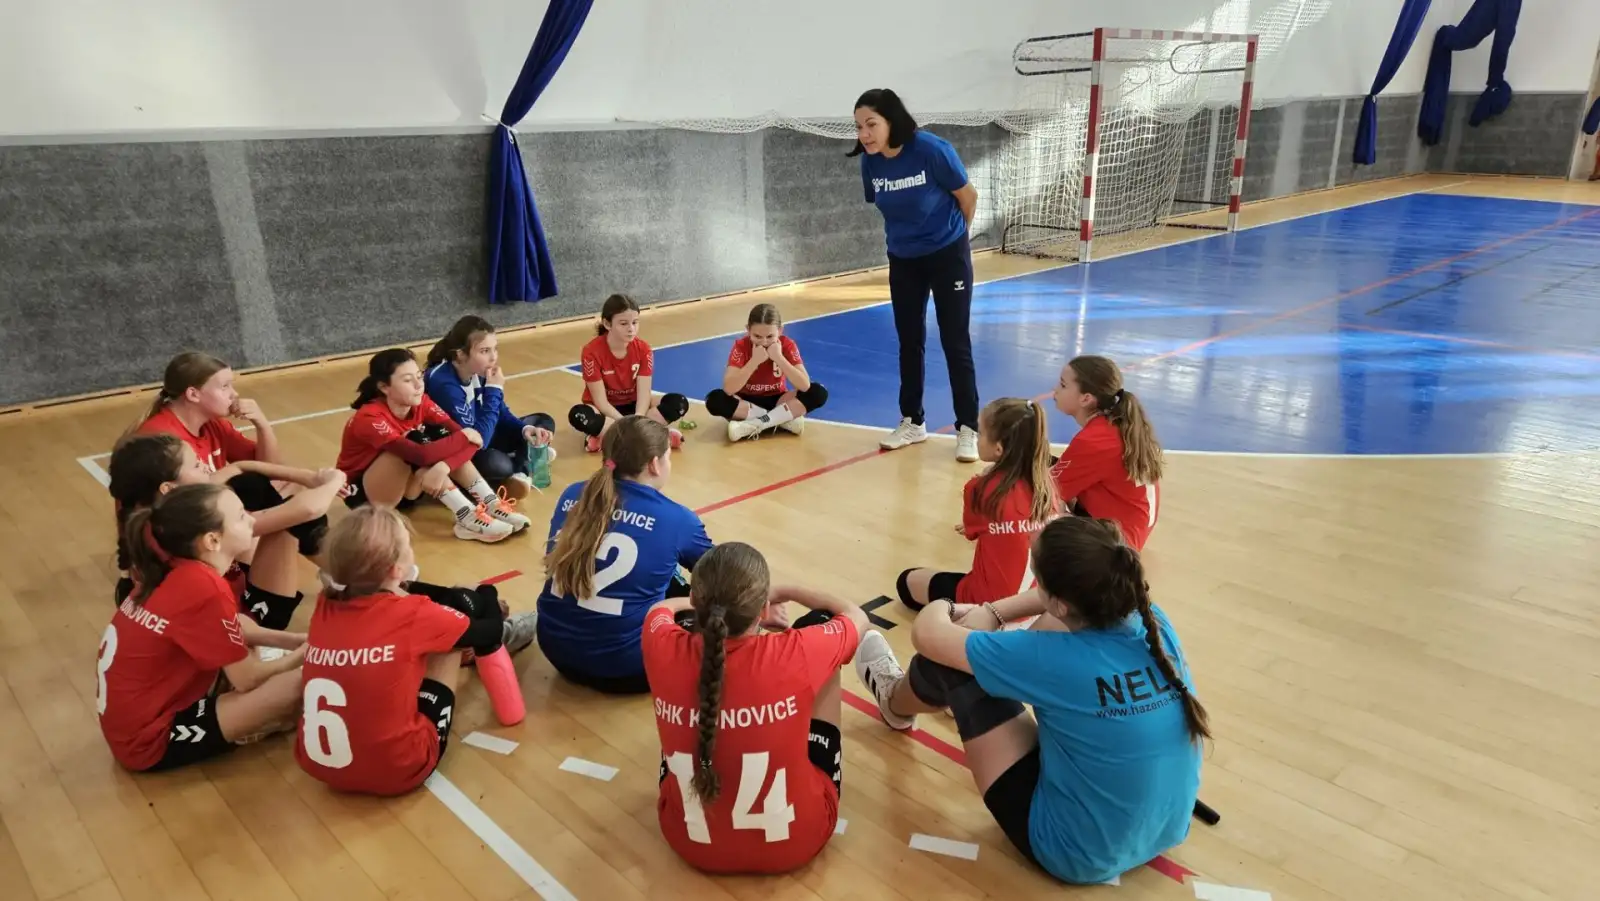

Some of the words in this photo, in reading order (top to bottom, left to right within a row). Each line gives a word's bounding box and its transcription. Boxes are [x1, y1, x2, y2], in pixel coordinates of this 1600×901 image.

[884, 170, 926, 192] hummel
[562, 499, 578, 512] SH
[612, 509, 656, 531] OVICE
[988, 521, 1015, 534] SHK
[305, 645, 395, 667] KUNOVICE
[1095, 666, 1171, 707] NEL
[303, 677, 354, 769] 6
[655, 697, 682, 726] SHK
[689, 695, 798, 730] KNOVICE
[666, 751, 796, 844] 14
